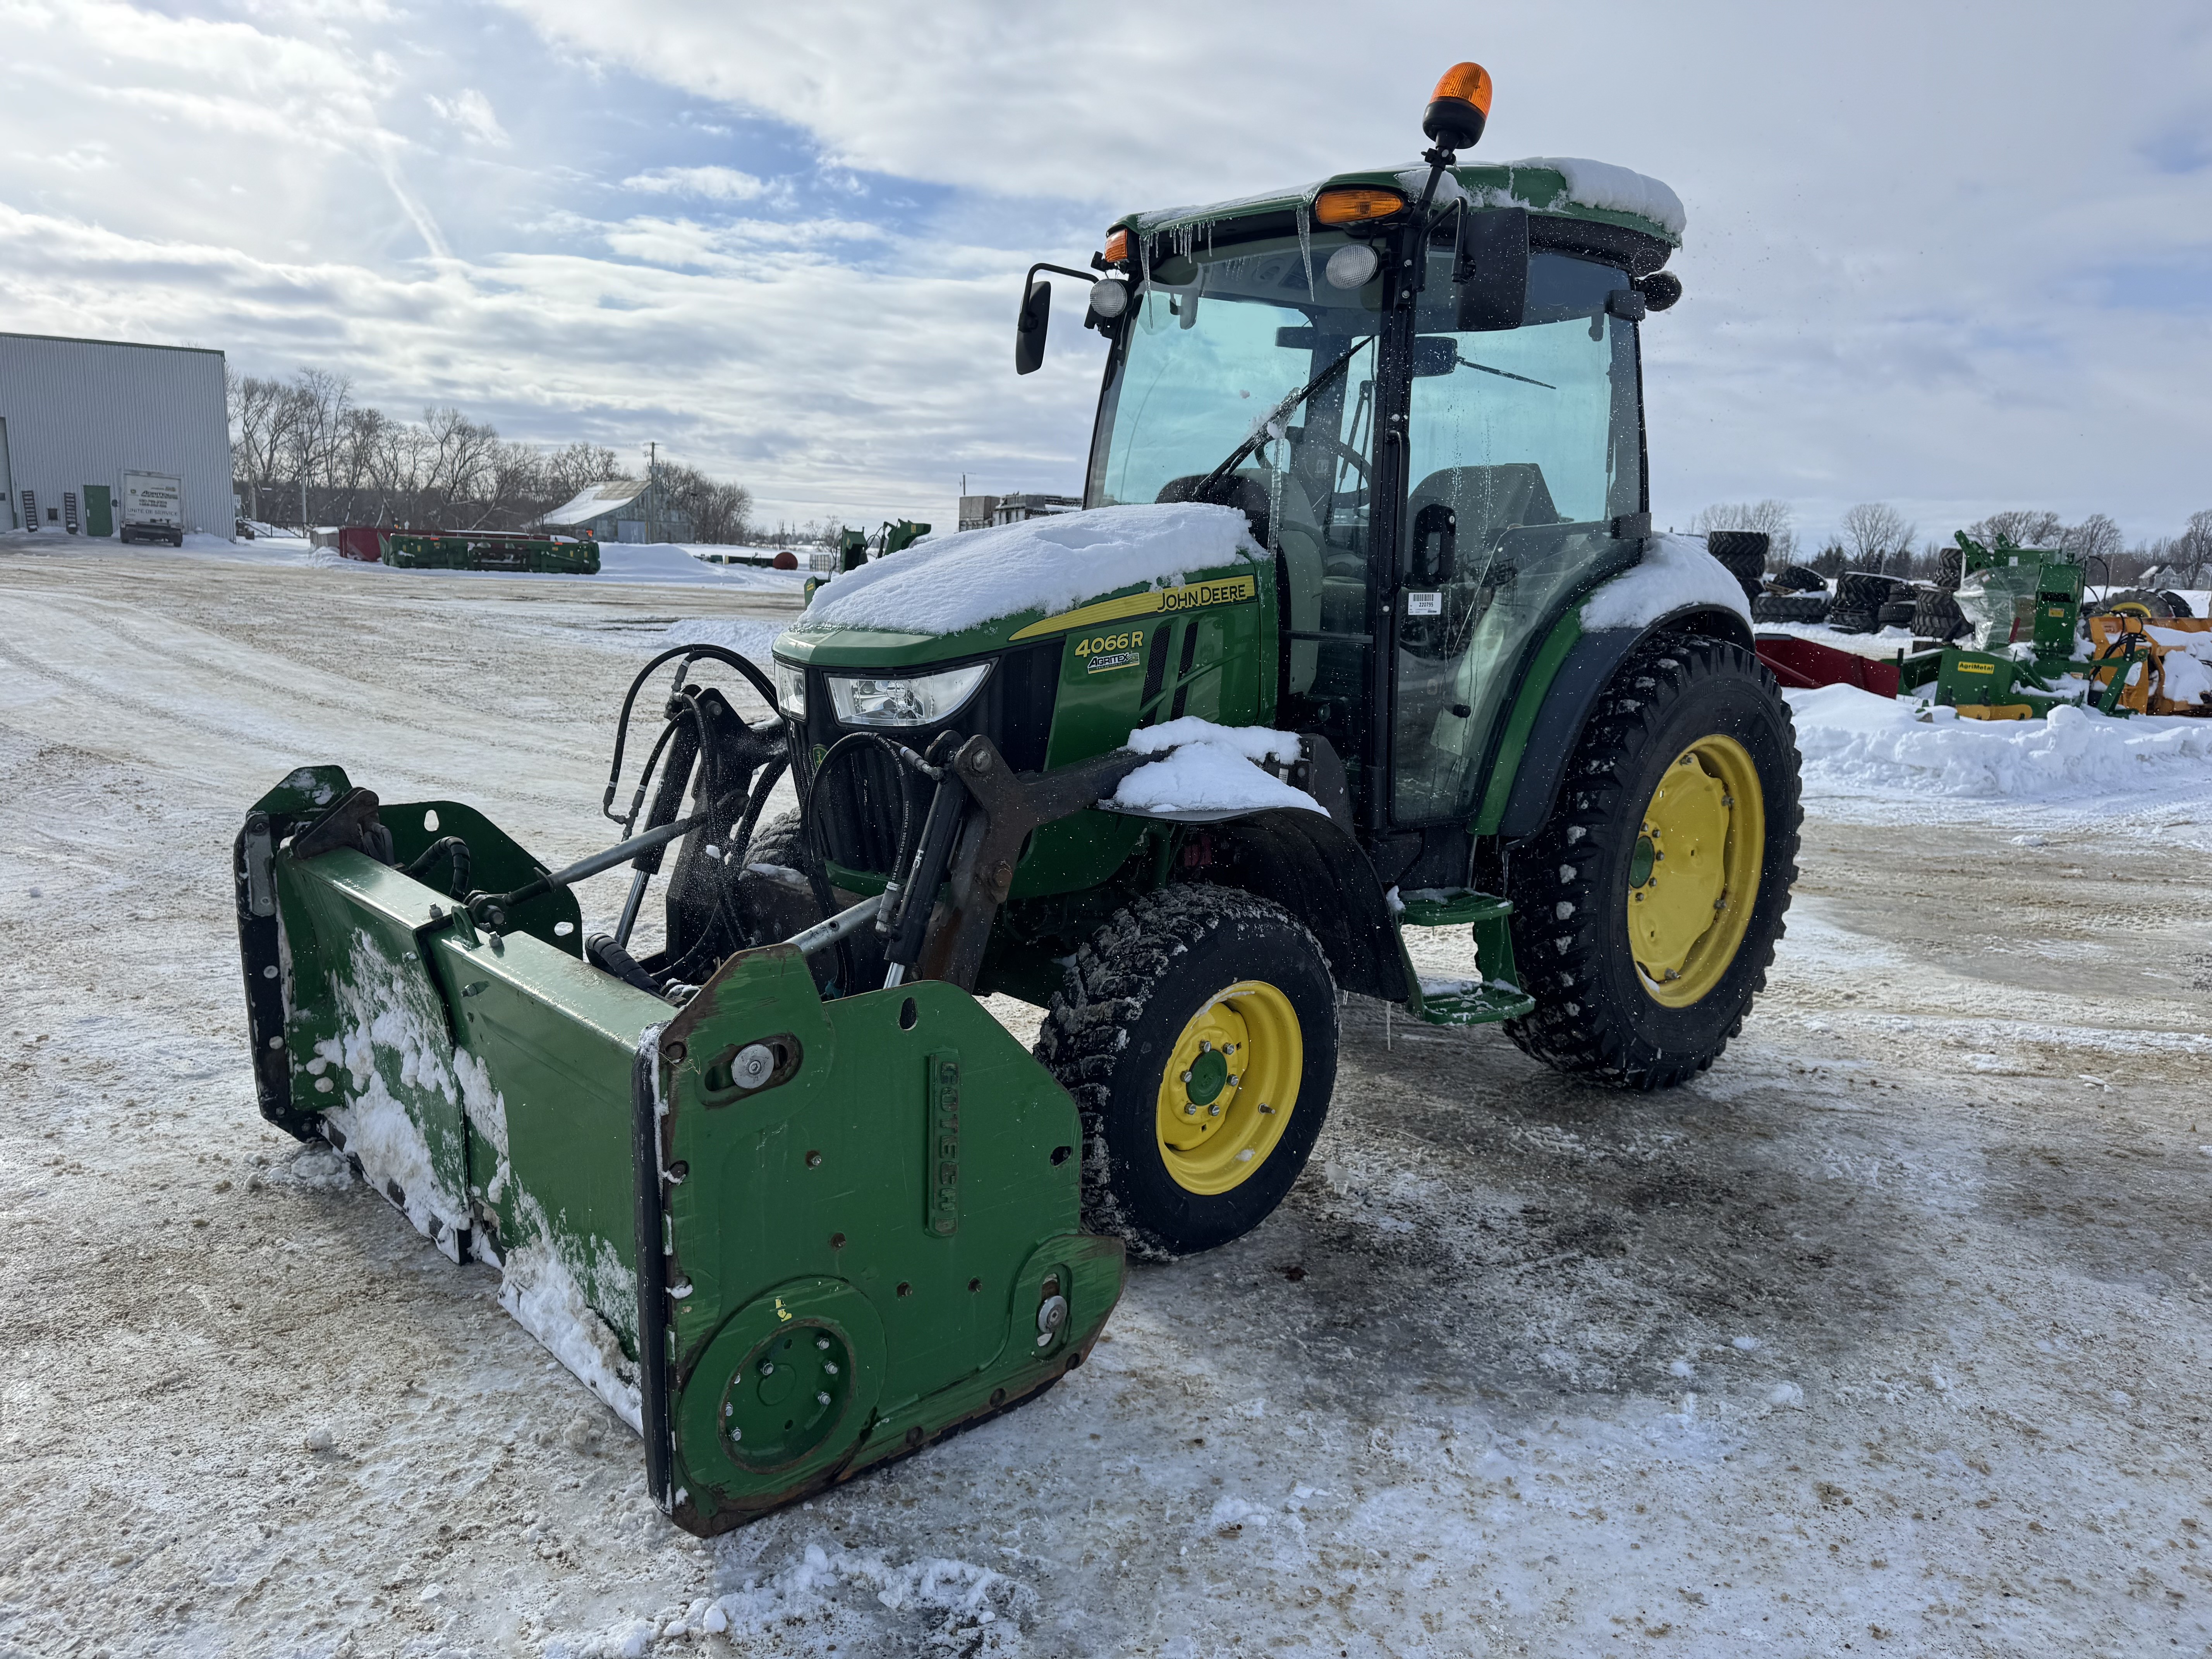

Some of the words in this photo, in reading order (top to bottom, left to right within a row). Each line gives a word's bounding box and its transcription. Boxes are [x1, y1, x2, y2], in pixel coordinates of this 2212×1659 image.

[1157, 591, 1198, 611] JOHN
[1200, 584, 1246, 603] DEERE
[1088, 653, 1128, 668] AGRITEX
[1960, 663, 1993, 671] AgriMetal
